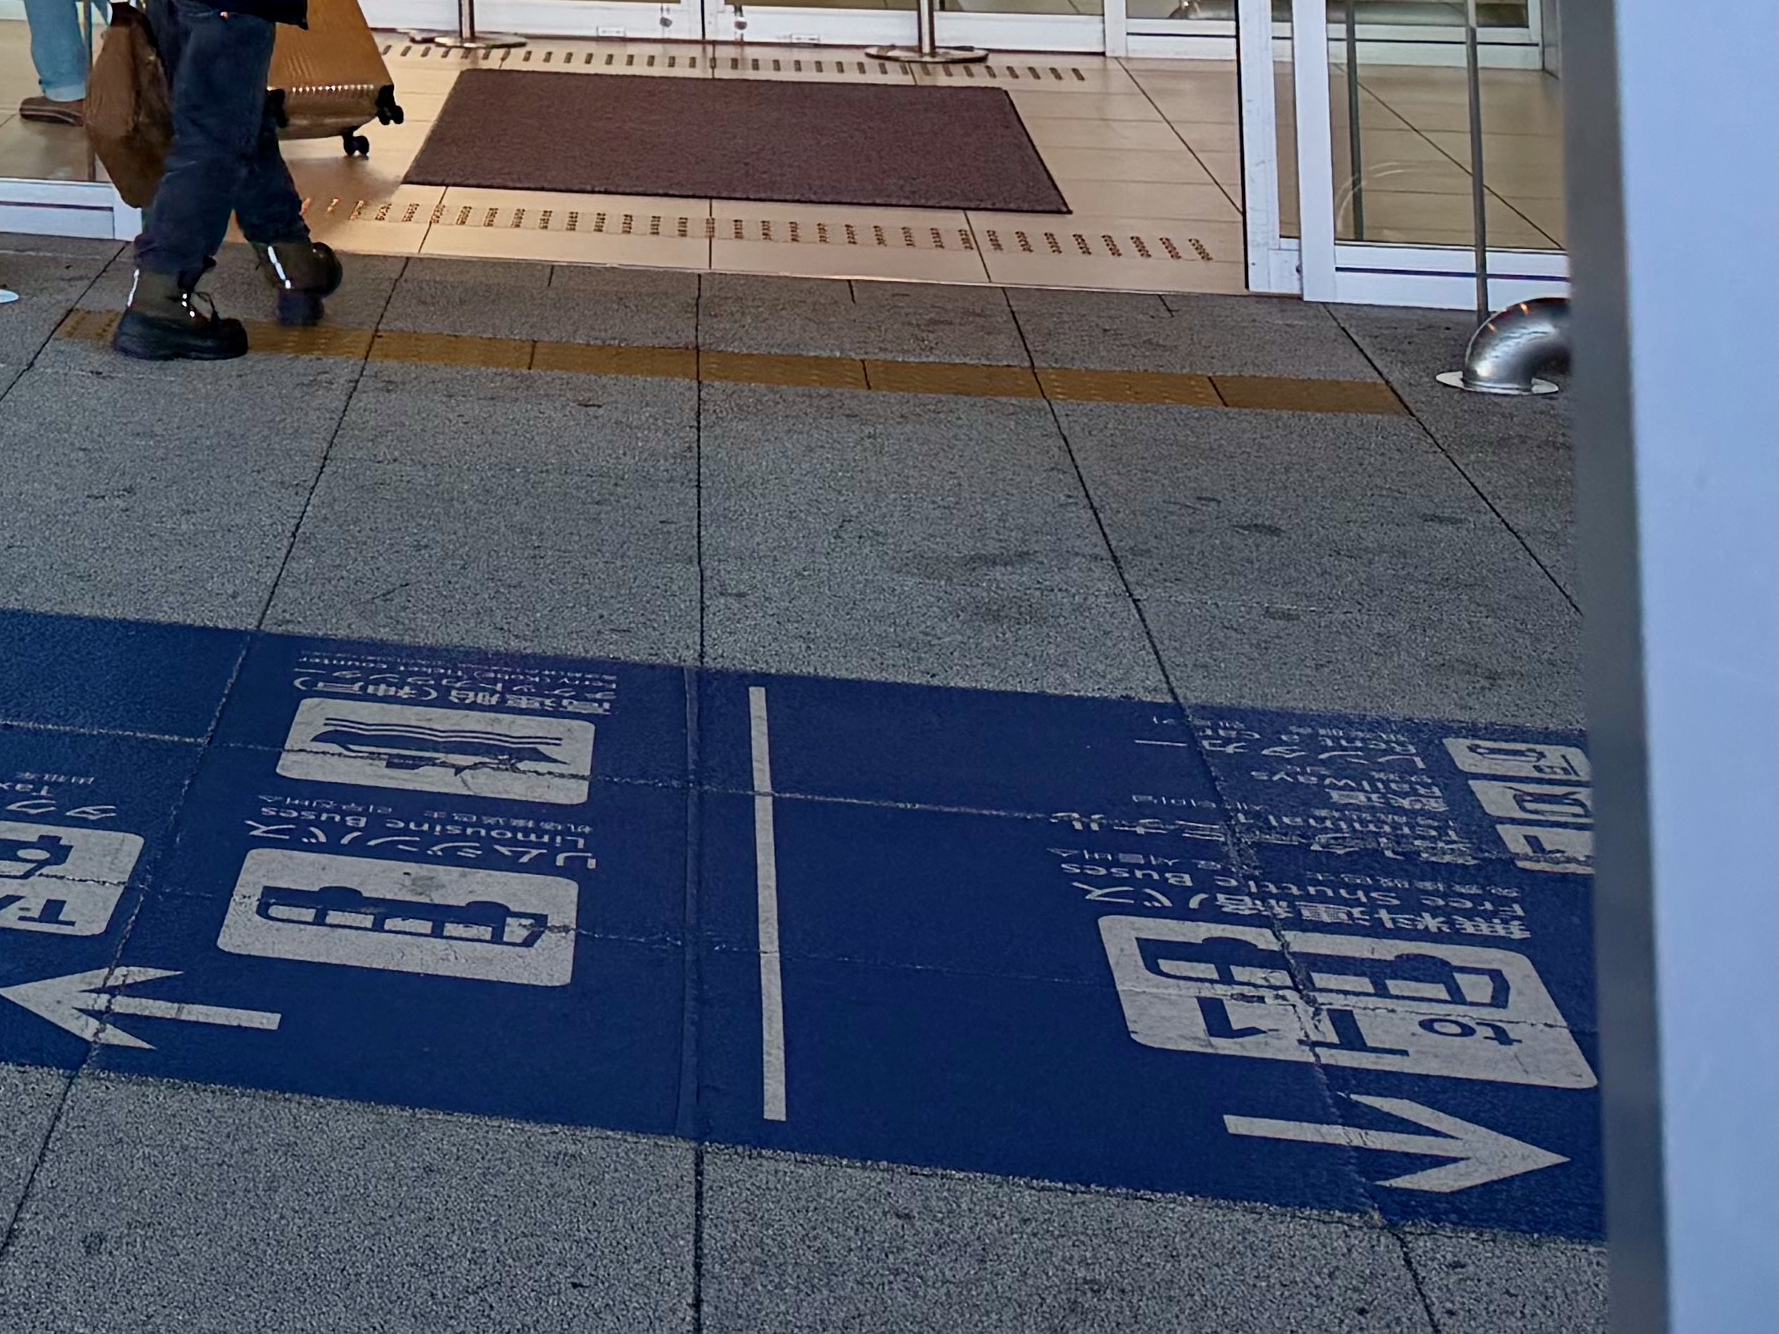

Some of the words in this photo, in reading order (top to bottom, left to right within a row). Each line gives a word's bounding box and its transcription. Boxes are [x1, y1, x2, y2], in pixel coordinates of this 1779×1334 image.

[1319, 736, 1417, 754] Rent
[1249, 771, 1442, 797] Railways
[260, 807, 367, 827] Buses
[1268, 815, 1459, 841] Terminal
[245, 820, 597, 869] リムジンバス
[385, 819, 585, 849] Limousine
[1060, 863, 1193, 886] Buses
[1214, 876, 1398, 906] Shuttle
[1071, 881, 1531, 939] 無料連絡バス
[1418, 896, 1526, 916] Free
[1418, 1018, 1524, 1047] to
